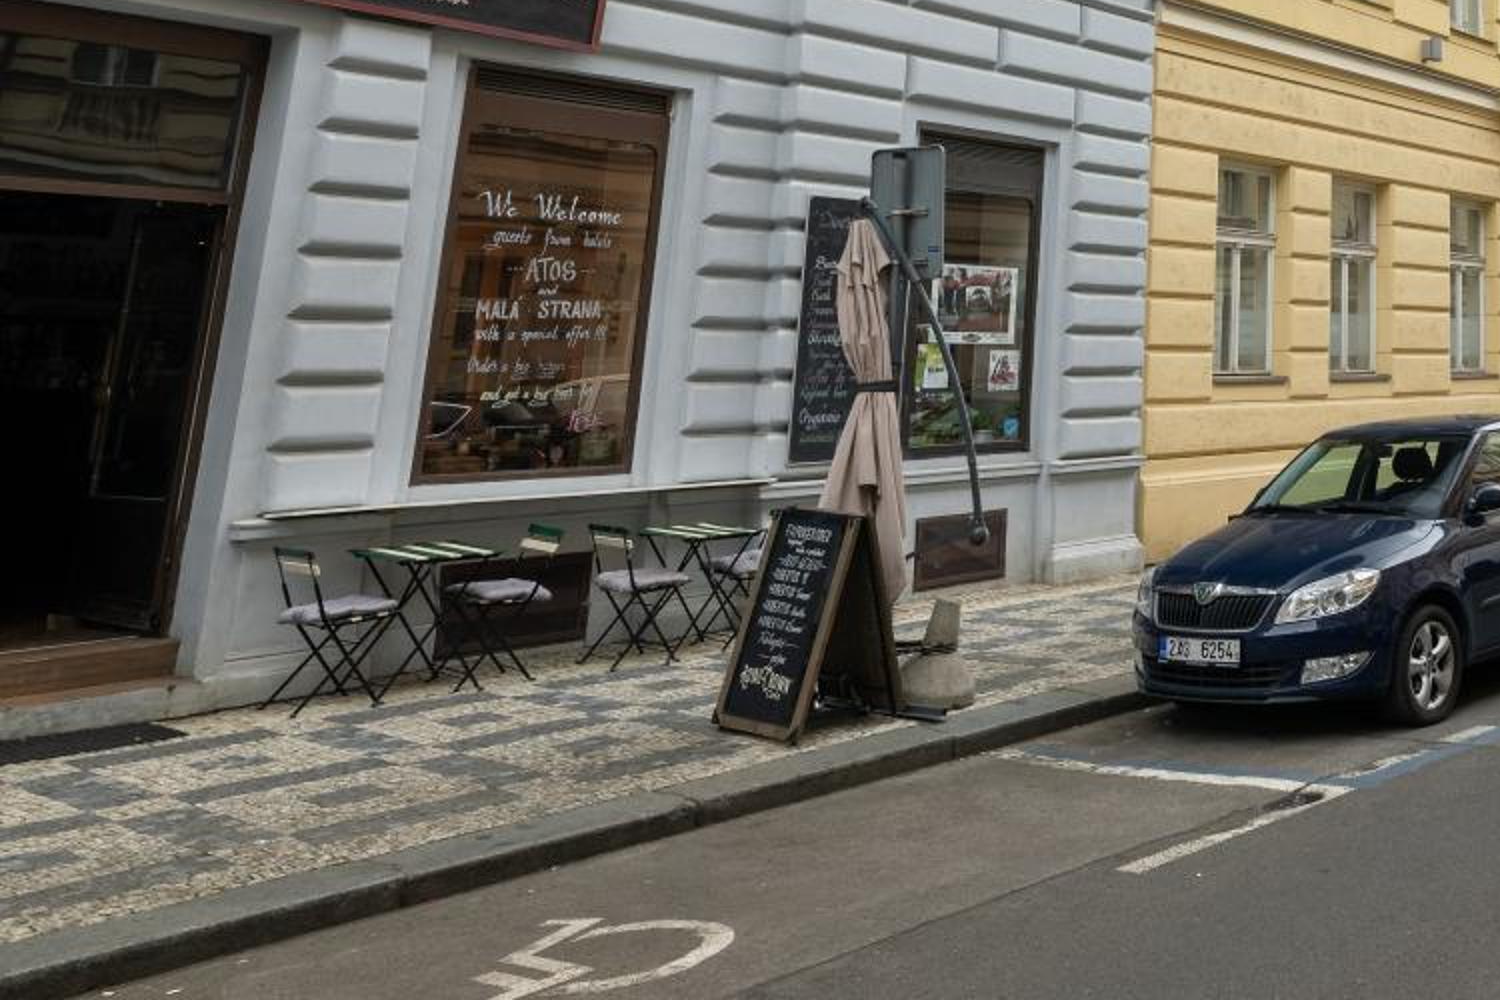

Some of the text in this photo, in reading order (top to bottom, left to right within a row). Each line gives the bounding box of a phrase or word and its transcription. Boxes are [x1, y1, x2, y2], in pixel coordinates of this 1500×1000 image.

[479, 190, 623, 225] We Welcome
[525, 255, 577, 282] ATOS
[537, 283, 559, 296] and
[537, 300, 602, 320] STRANA
